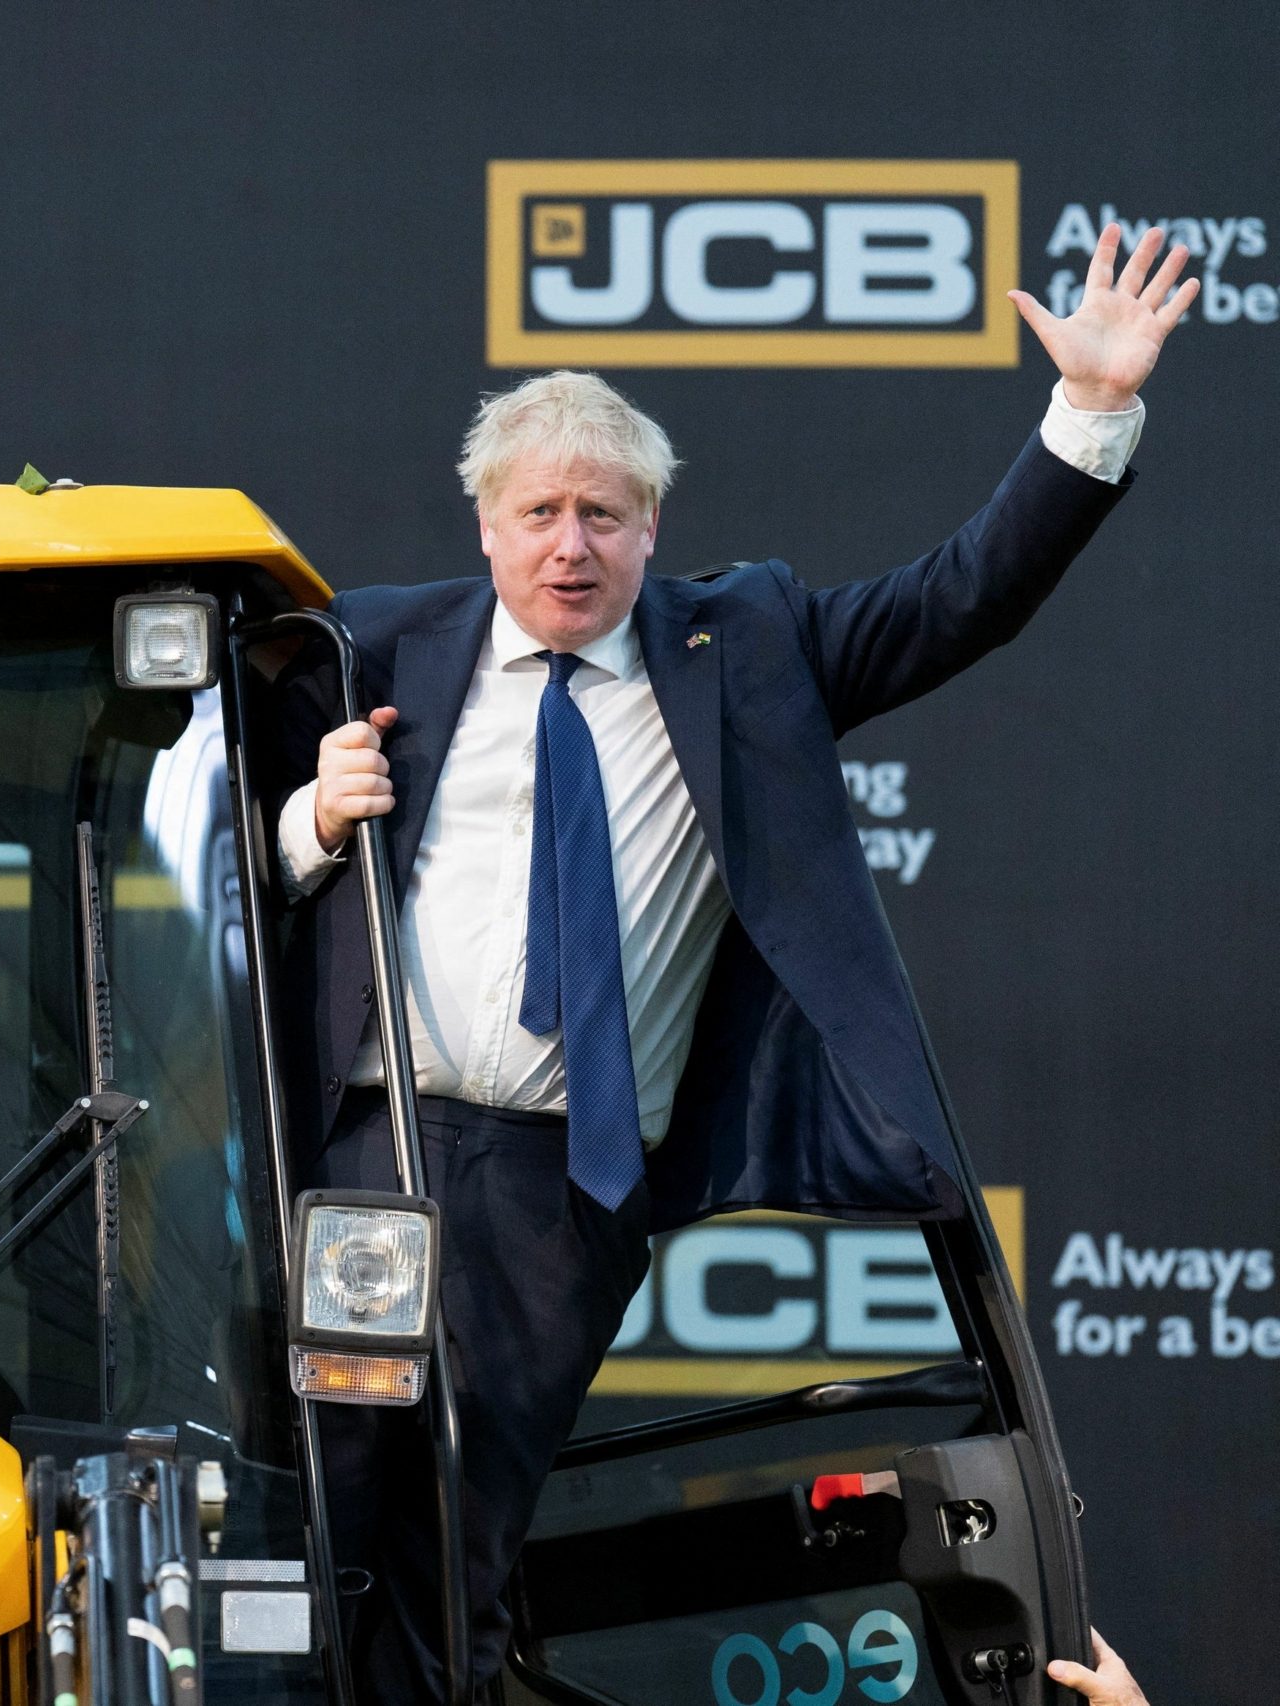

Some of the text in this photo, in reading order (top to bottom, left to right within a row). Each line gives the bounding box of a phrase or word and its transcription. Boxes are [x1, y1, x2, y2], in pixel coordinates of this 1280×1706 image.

[530, 200, 976, 326] JCB
[857, 827, 936, 885] ay
[1051, 1231, 1275, 1302] Always
[1051, 1299, 1147, 1357] for
[1157, 1315, 1197, 1358] a
